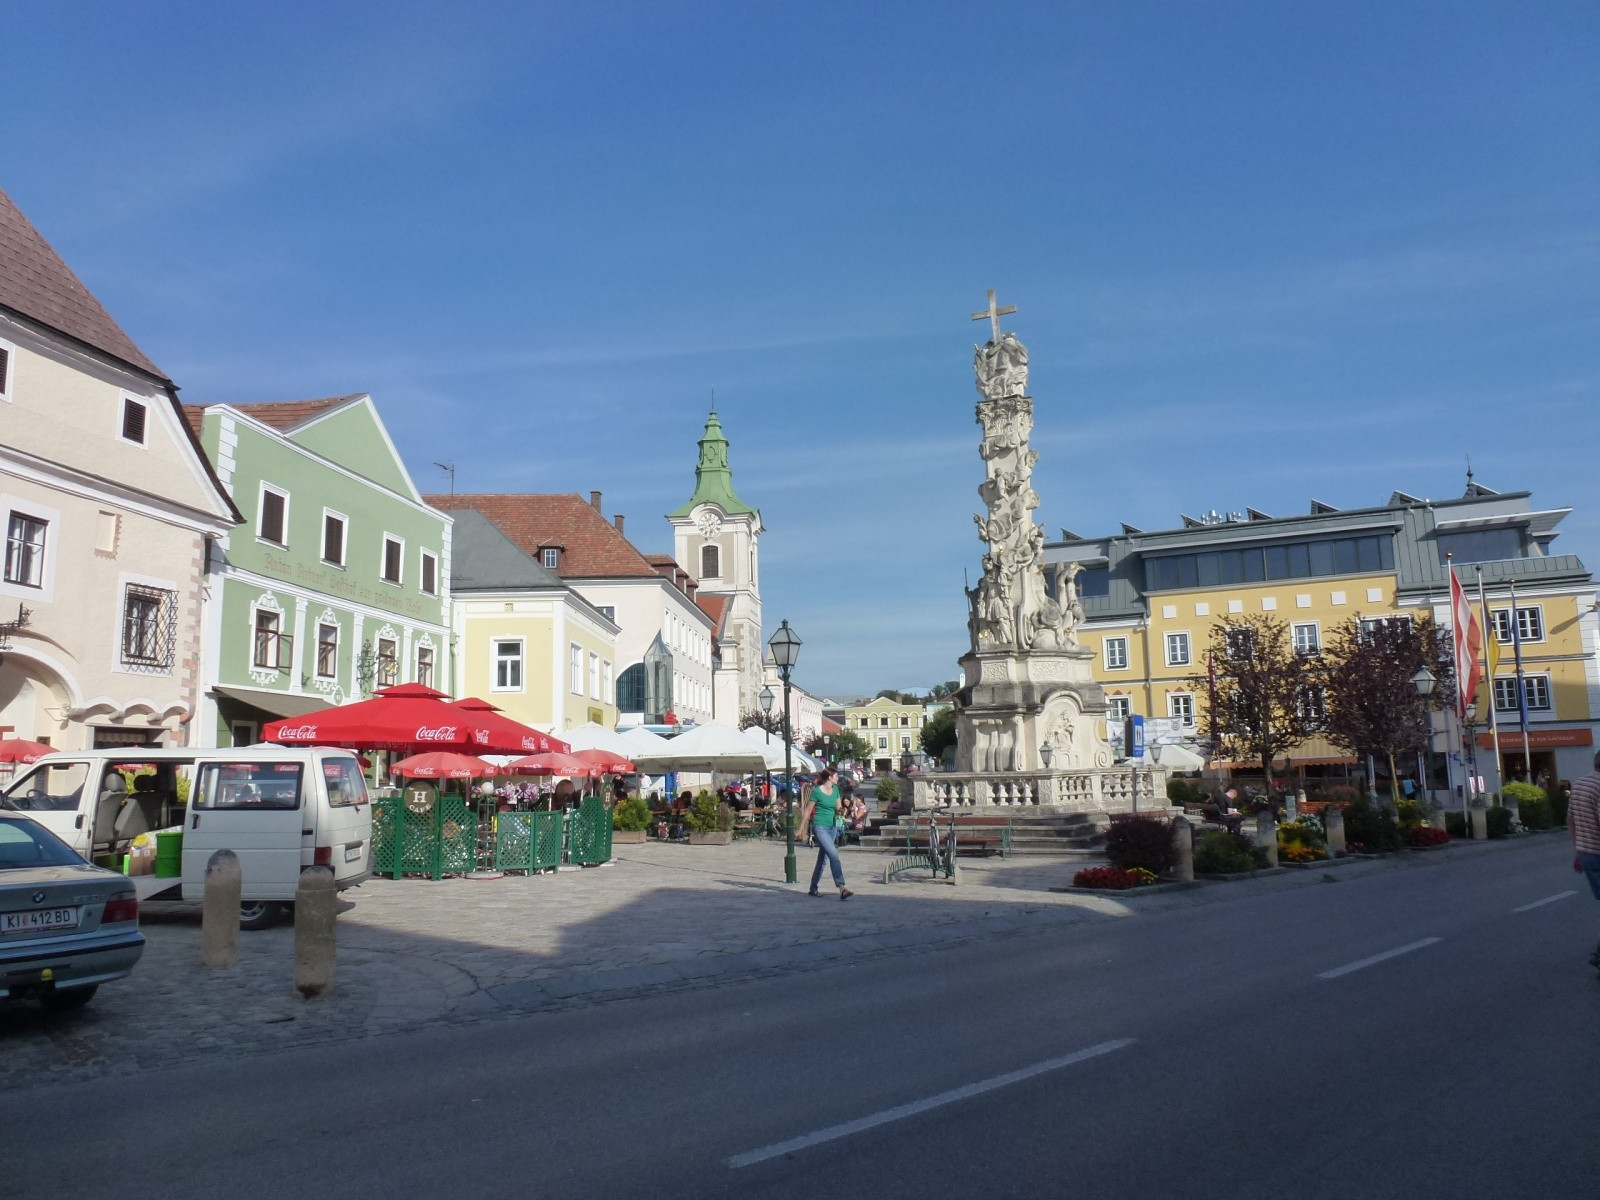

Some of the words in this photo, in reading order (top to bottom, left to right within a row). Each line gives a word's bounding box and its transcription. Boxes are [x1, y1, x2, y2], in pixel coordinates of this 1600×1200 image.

[278, 725, 317, 739] Coca-Cola
[416, 726, 457, 740] Coca-Cola
[413, 791, 427, 803] H
[7, 914, 20, 928] KI
[30, 911, 52, 925] 412
[55, 909, 71, 923] BD
